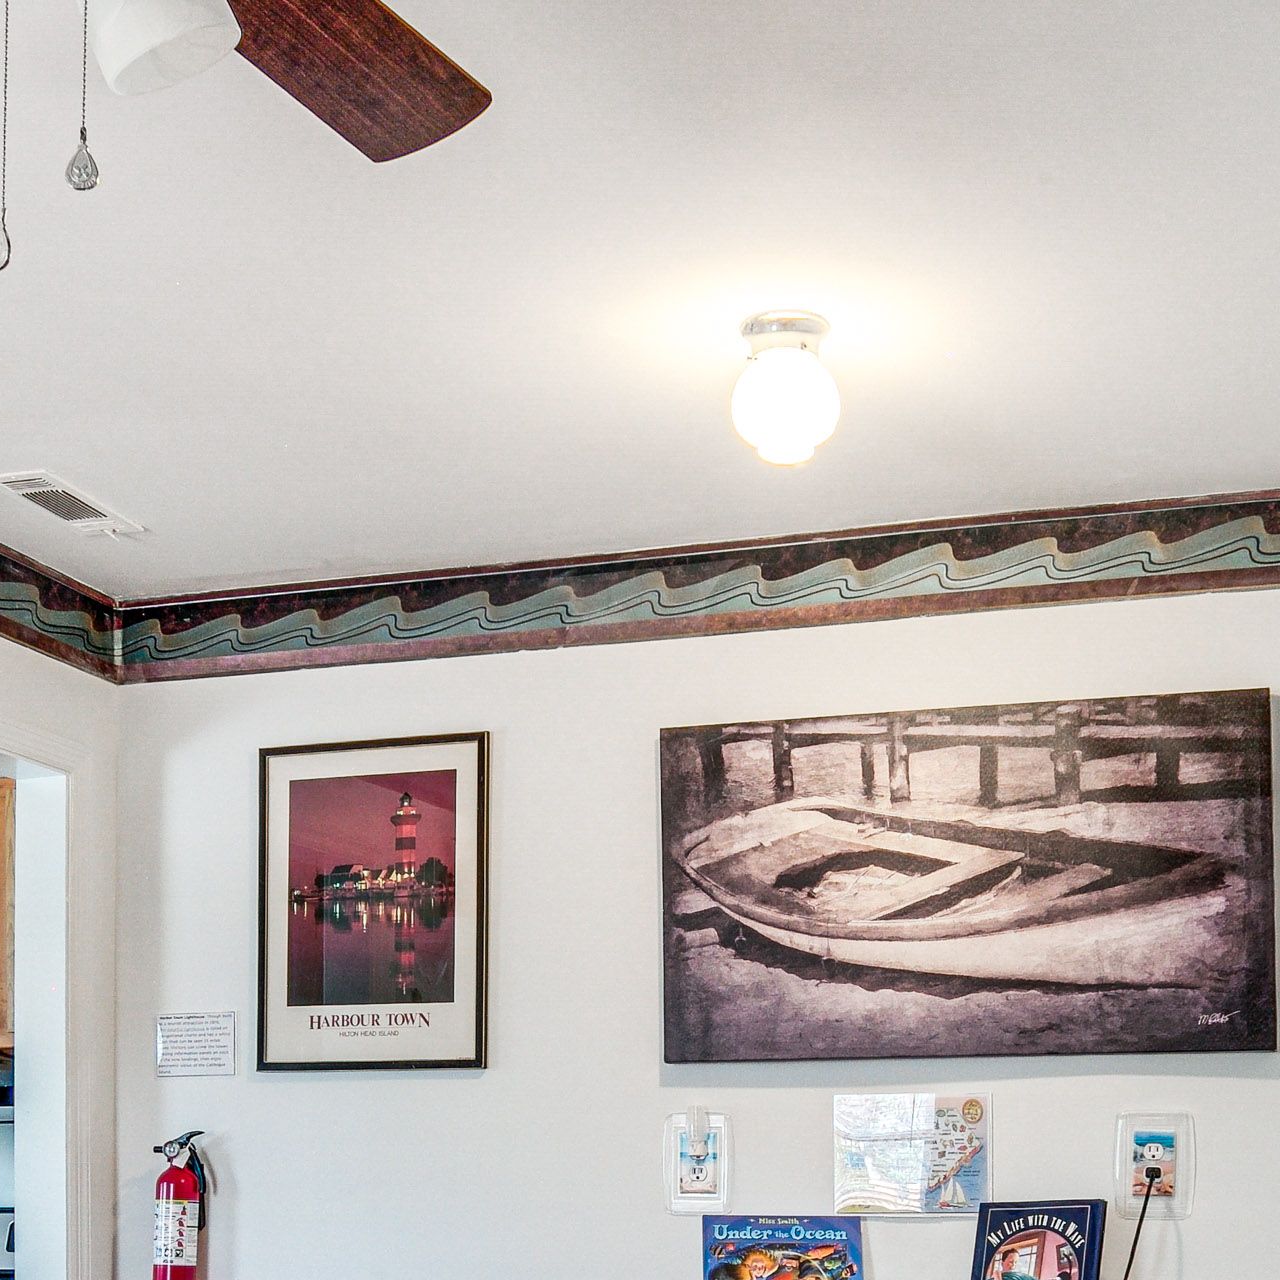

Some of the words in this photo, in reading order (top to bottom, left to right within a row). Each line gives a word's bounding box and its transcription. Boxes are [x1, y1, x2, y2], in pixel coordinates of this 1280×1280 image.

[310, 1013, 380, 1029] HARBOUR
[386, 1013, 430, 1027] TOWN
[713, 1224, 772, 1240] Under
[775, 1230, 789, 1238] the
[790, 1226, 848, 1240] Ocean
